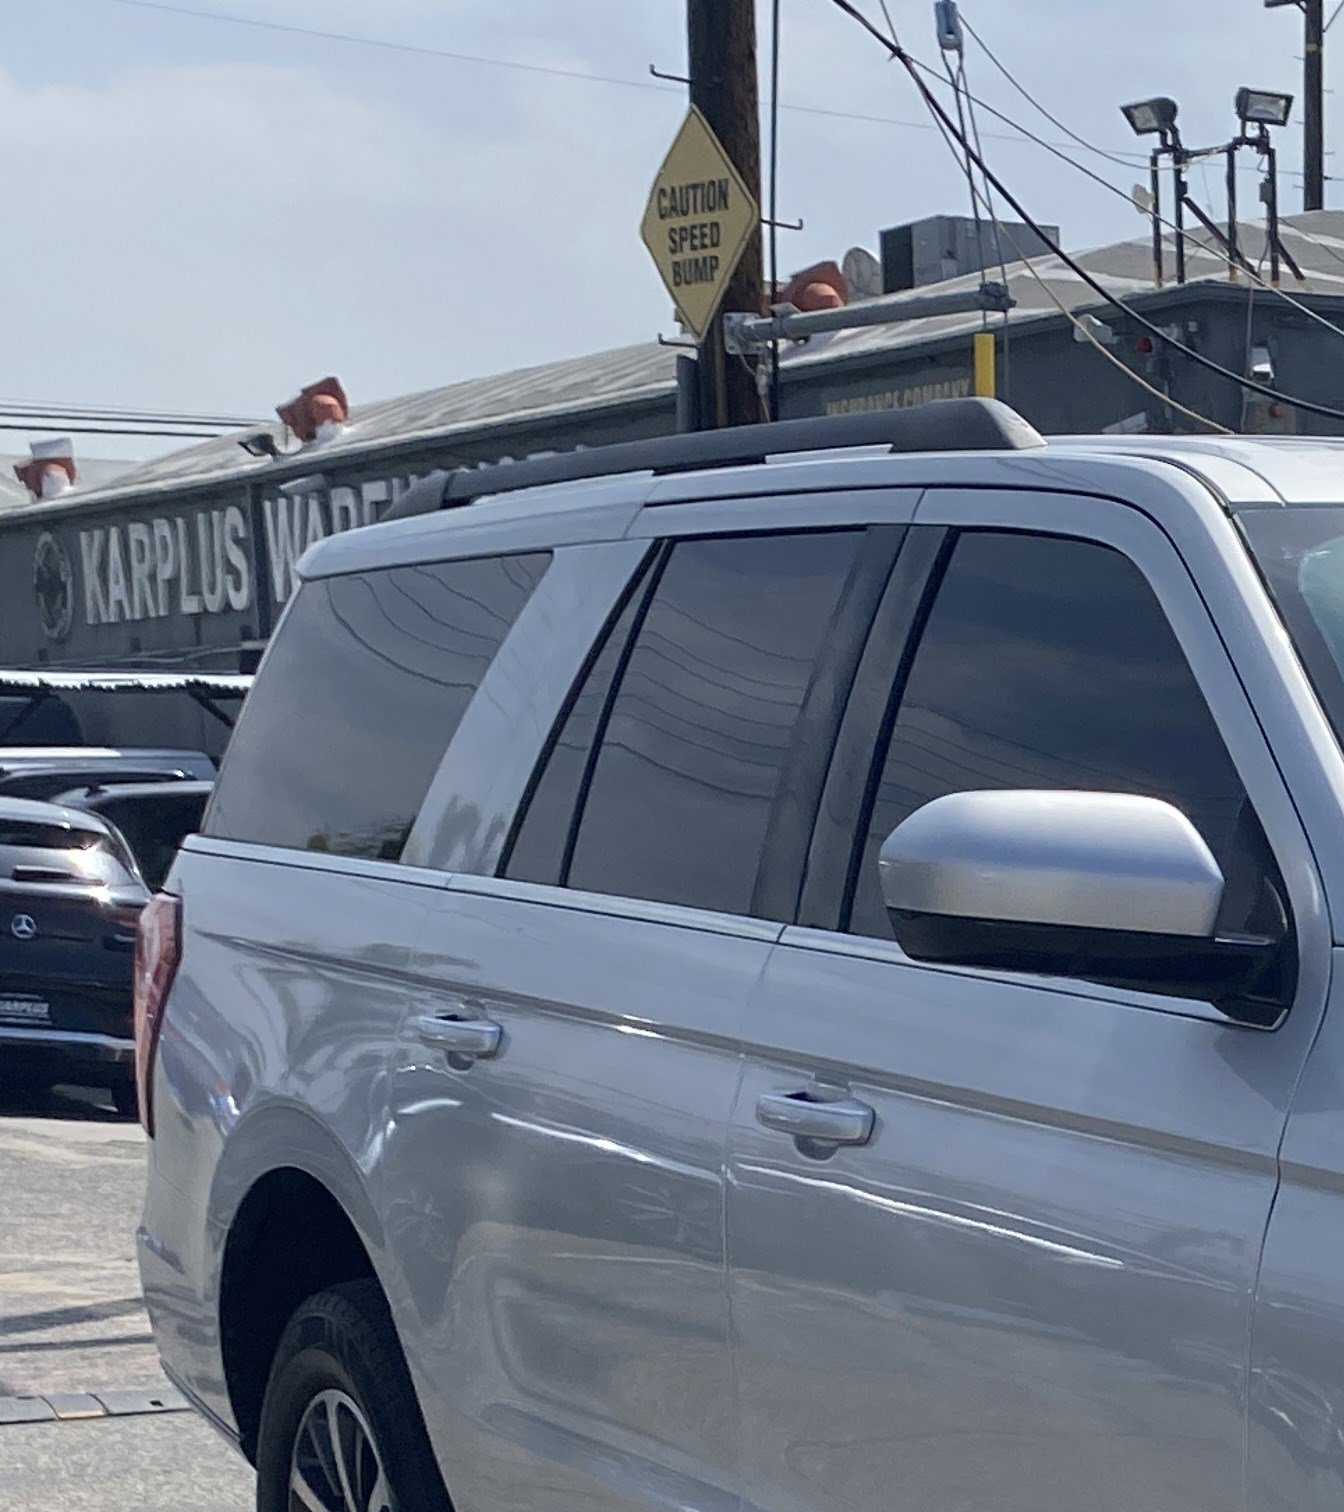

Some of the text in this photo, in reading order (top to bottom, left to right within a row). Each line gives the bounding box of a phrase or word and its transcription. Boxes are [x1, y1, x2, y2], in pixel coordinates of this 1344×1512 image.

[657, 178, 729, 220] CAUTION
[668, 222, 721, 255] SPEED
[672, 256, 719, 287] BUMP
[80, 506, 249, 625] KARPLUS
